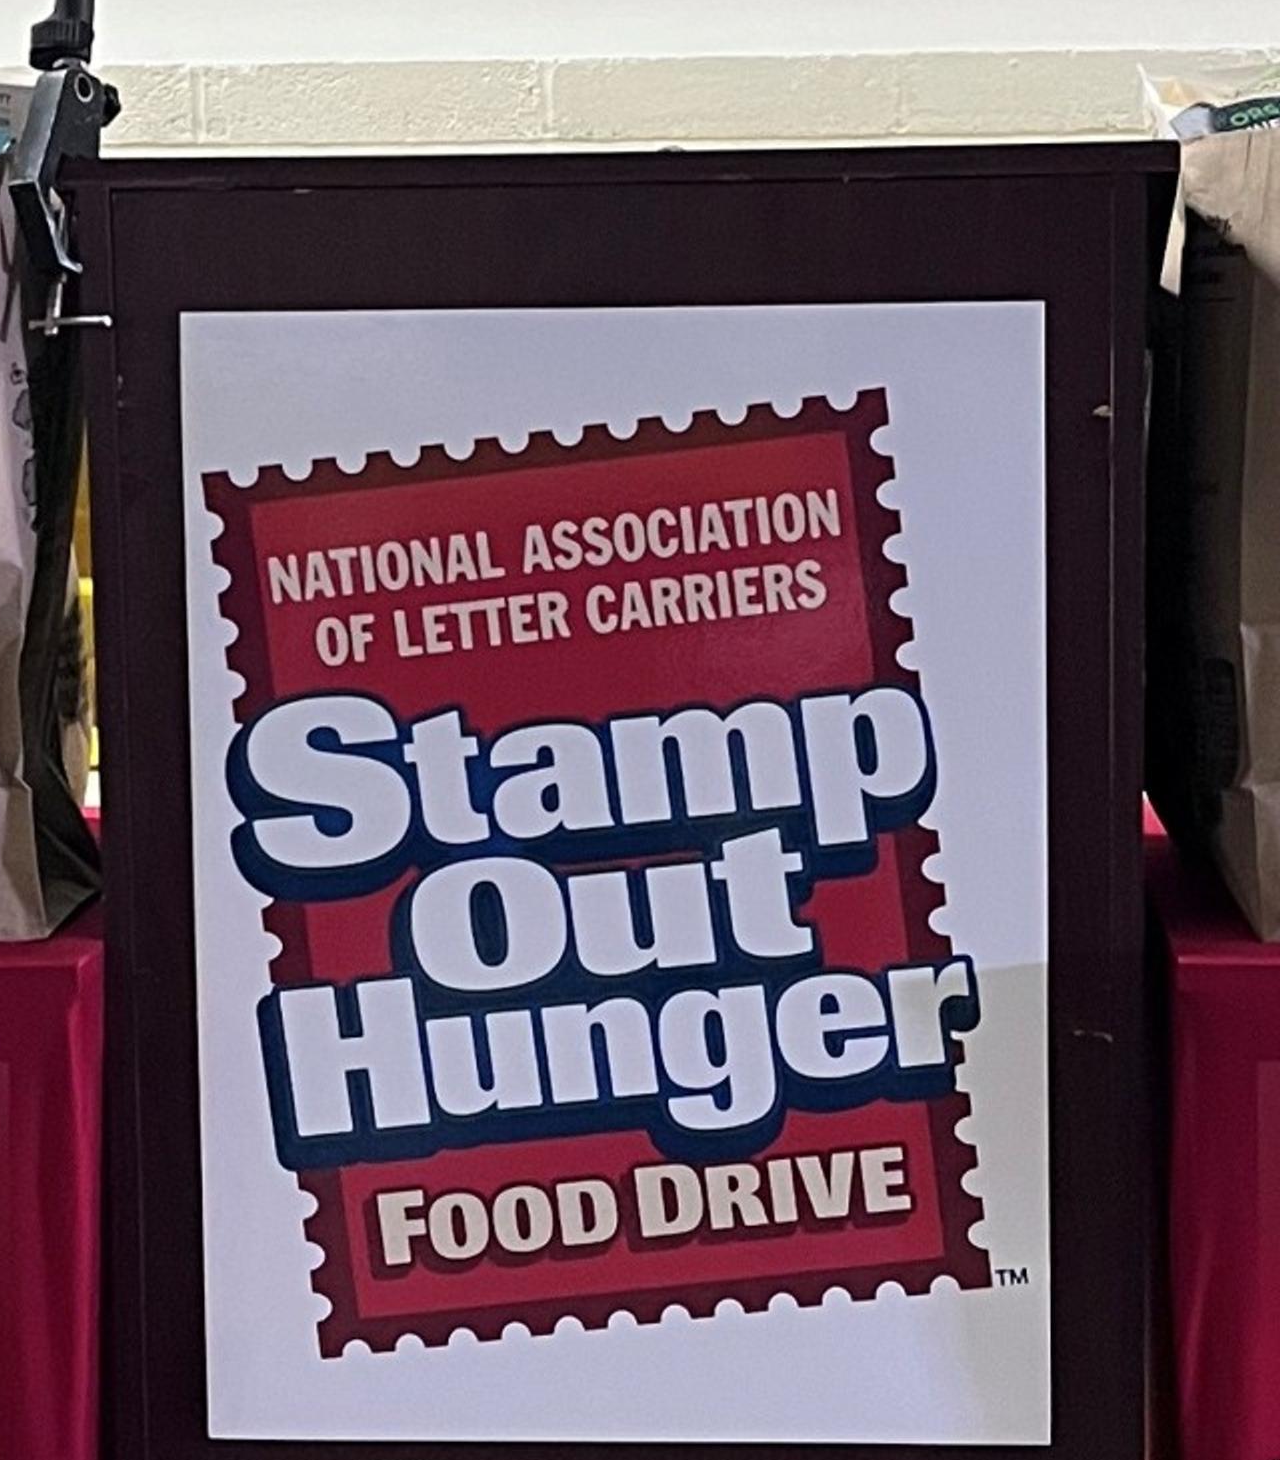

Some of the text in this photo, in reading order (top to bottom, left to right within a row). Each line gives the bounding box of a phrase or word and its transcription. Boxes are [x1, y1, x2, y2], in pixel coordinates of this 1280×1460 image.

[267, 488, 841, 603] NATIONAL ASSOCIATION
[316, 560, 828, 666] OF LETTER CARRIERS
[246, 686, 924, 869] Stamp
[409, 826, 815, 993] Out
[278, 961, 970, 1138] Hunger
[377, 1146, 912, 1267] FOOD DRIVE
[995, 1268, 1030, 1286] TM
